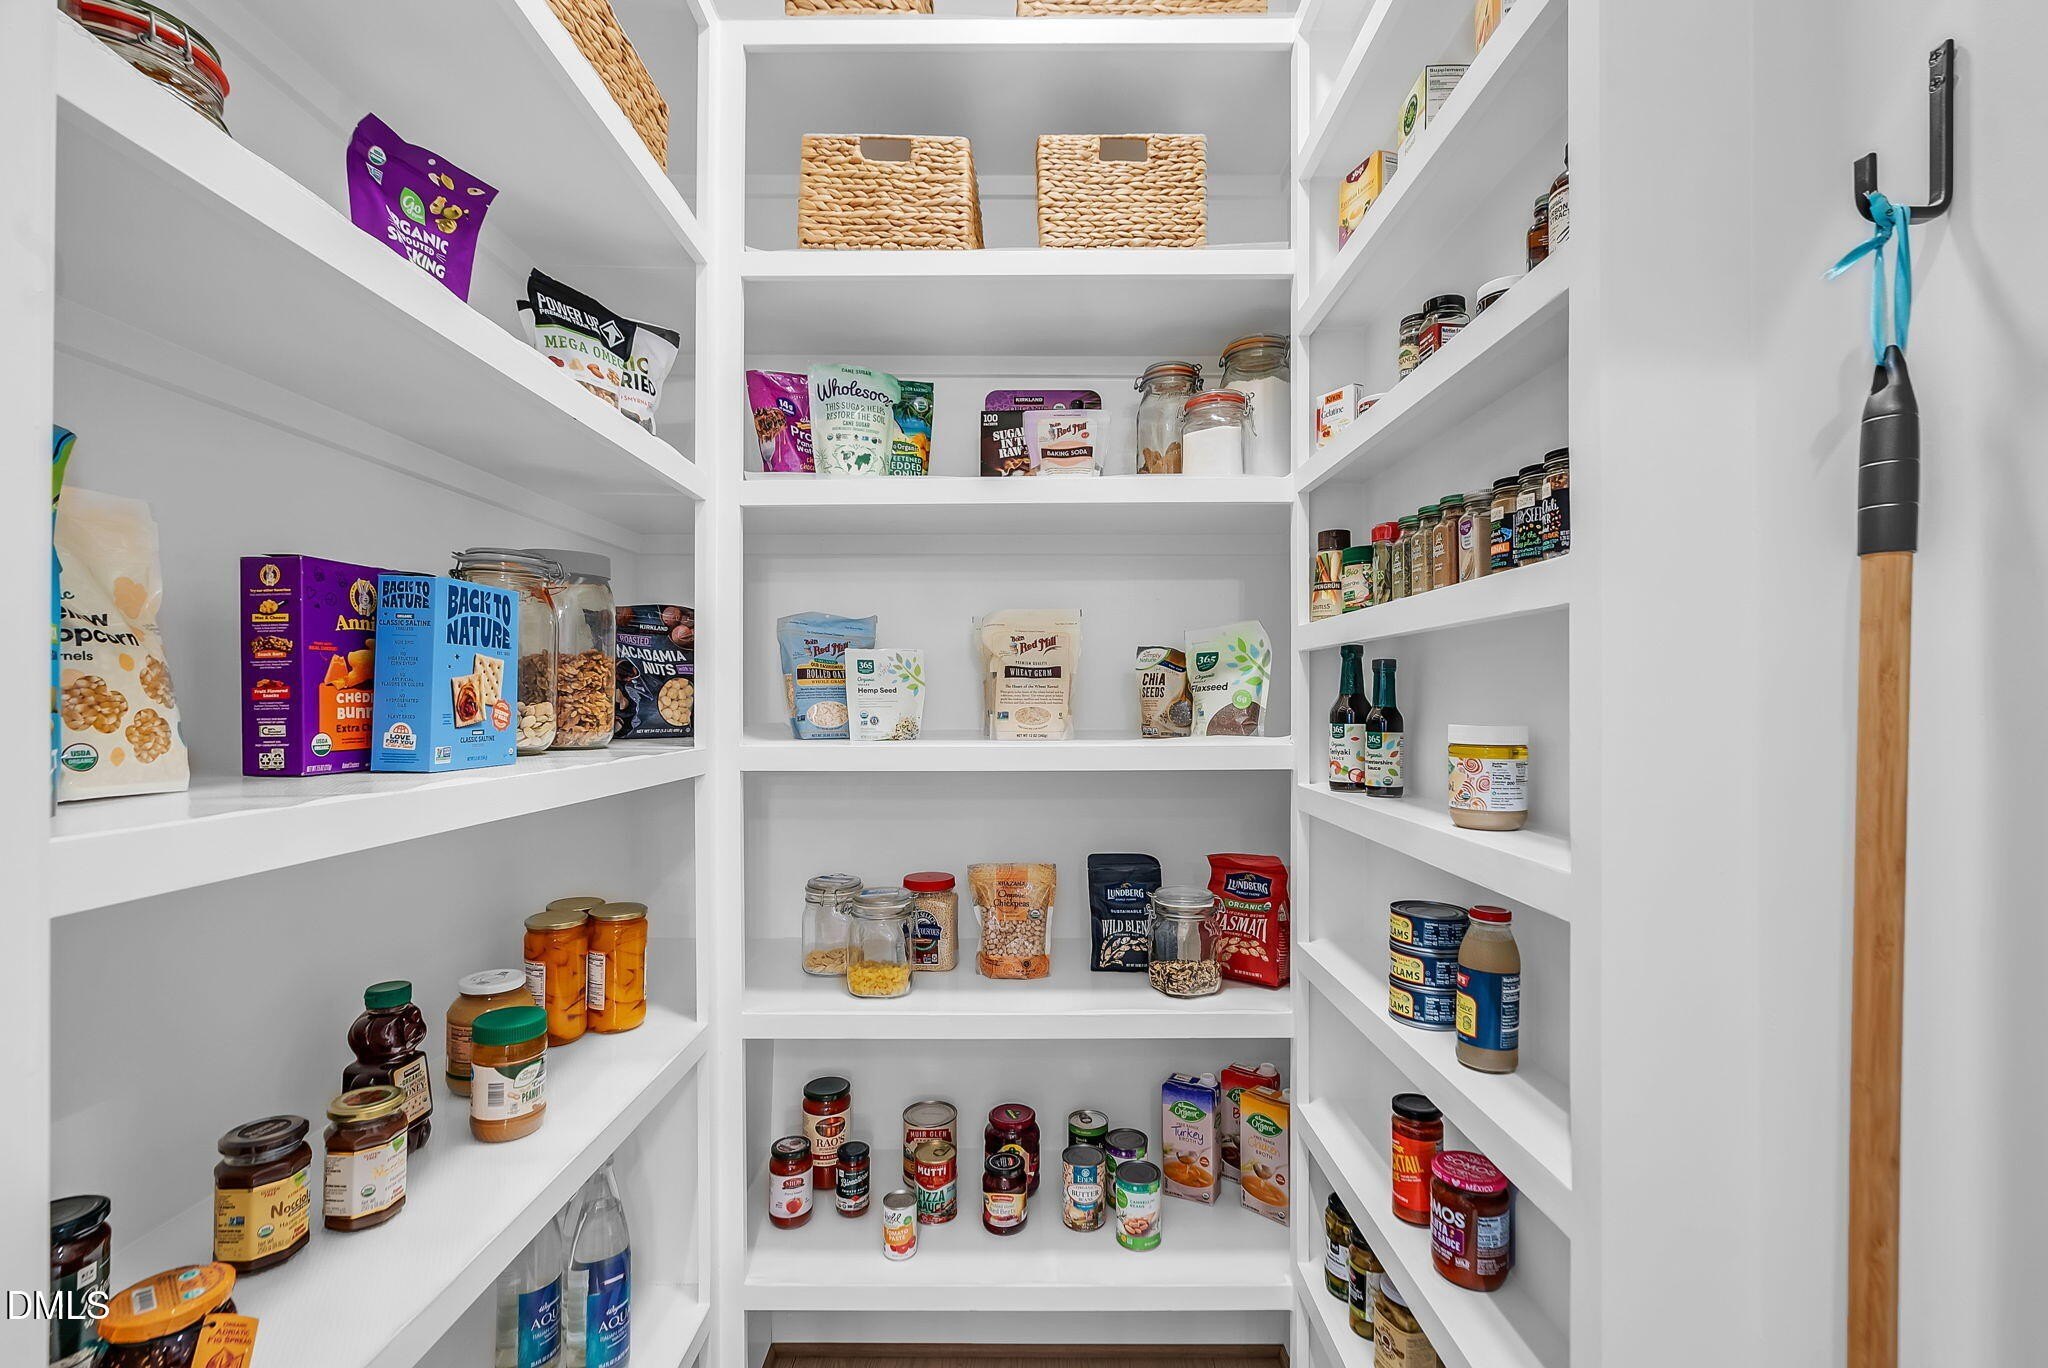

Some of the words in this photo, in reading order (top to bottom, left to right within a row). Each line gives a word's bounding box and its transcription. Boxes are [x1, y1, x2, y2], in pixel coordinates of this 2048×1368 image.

[537, 292, 583, 324] POWER
[583, 311, 600, 329] UP
[539, 308, 572, 323] PREMIUM
[544, 335, 588, 355] MEGA
[855, 369, 872, 377] SUGAR
[825, 403, 840, 411] THIS
[841, 403, 865, 412] SUGAR
[867, 406, 886, 416] HELPS
[826, 411, 856, 421] RESTORE
[857, 412, 871, 421] THE
[873, 414, 886, 425] SOIL
[983, 414, 998, 423] 100
[855, 421, 870, 429] SUGAR
[1056, 425, 1072, 439] Red
[1071, 421, 1088, 435] Mill
[1001, 437, 1015, 449] IN
[999, 446, 1022, 459] RAW
[891, 461, 922, 472] EDDED
[383, 580, 416, 595] BACK
[416, 581, 430, 597] TO
[382, 593, 430, 609] NATURE
[448, 584, 492, 620] BACK
[493, 593, 511, 627] TO
[335, 614, 376, 632] Anni
[379, 619, 406, 627] CLASSIC
[407, 619, 431, 627] SALTINE
[639, 624, 669, 632] KIRKLAND
[447, 616, 511, 650] NATURE
[813, 644, 831, 657] Red
[831, 641, 850, 656] Mill
[1019, 640, 1038, 656] Red
[1038, 636, 1058, 652] Mill
[858, 662, 873, 670] 365
[1198, 655, 1216, 665] 365
[643, 661, 676, 676] NUTS
[806, 669, 831, 679] ROLLED
[1009, 667, 1032, 677] WHEAT
[1033, 668, 1053, 677] GERM
[857, 687, 879, 695] Hemp
[1142, 687, 1165, 698] SEEDS
[1191, 682, 1229, 693] Flaxseed
[336, 724, 360, 733] Extra
[1332, 726, 1344, 734] 365
[1368, 735, 1381, 744] 365
[64, 756, 97, 765] ORGANIC
[1227, 877, 1269, 894] LUNDBERG
[998, 889, 1026, 901] Organic
[1107, 888, 1144, 899] LUNDBERG
[993, 900, 1030, 910] Chickpeas
[1228, 900, 1263, 911] ORGANIC
[1102, 919, 1123, 937] WILD
[1392, 965, 1420, 981] CLAMS
[1174, 1106, 1200, 1120] Organic
[1251, 1118, 1276, 1135] Organic
[816, 1134, 845, 1148] RAO'S
[910, 1131, 927, 1139] MUIR
[929, 1131, 947, 1139] GLEN
[1171, 1125, 1204, 1146] Turkey
[1178, 1136, 1197, 1144] BROTH
[1255, 1149, 1273, 1160] BROTH
[917, 1165, 947, 1177] MUTTI
[917, 1189, 945, 1203] PIZZA
[1071, 1189, 1099, 1198] BUTTER
[918, 1201, 946, 1214] SAUCE
[1432, 1198, 1466, 1229] MOS
[1437, 1231, 1461, 1252] SAUCE
[207, 1336, 222, 1344] FIG
[224, 1337, 252, 1345] SPREAD
